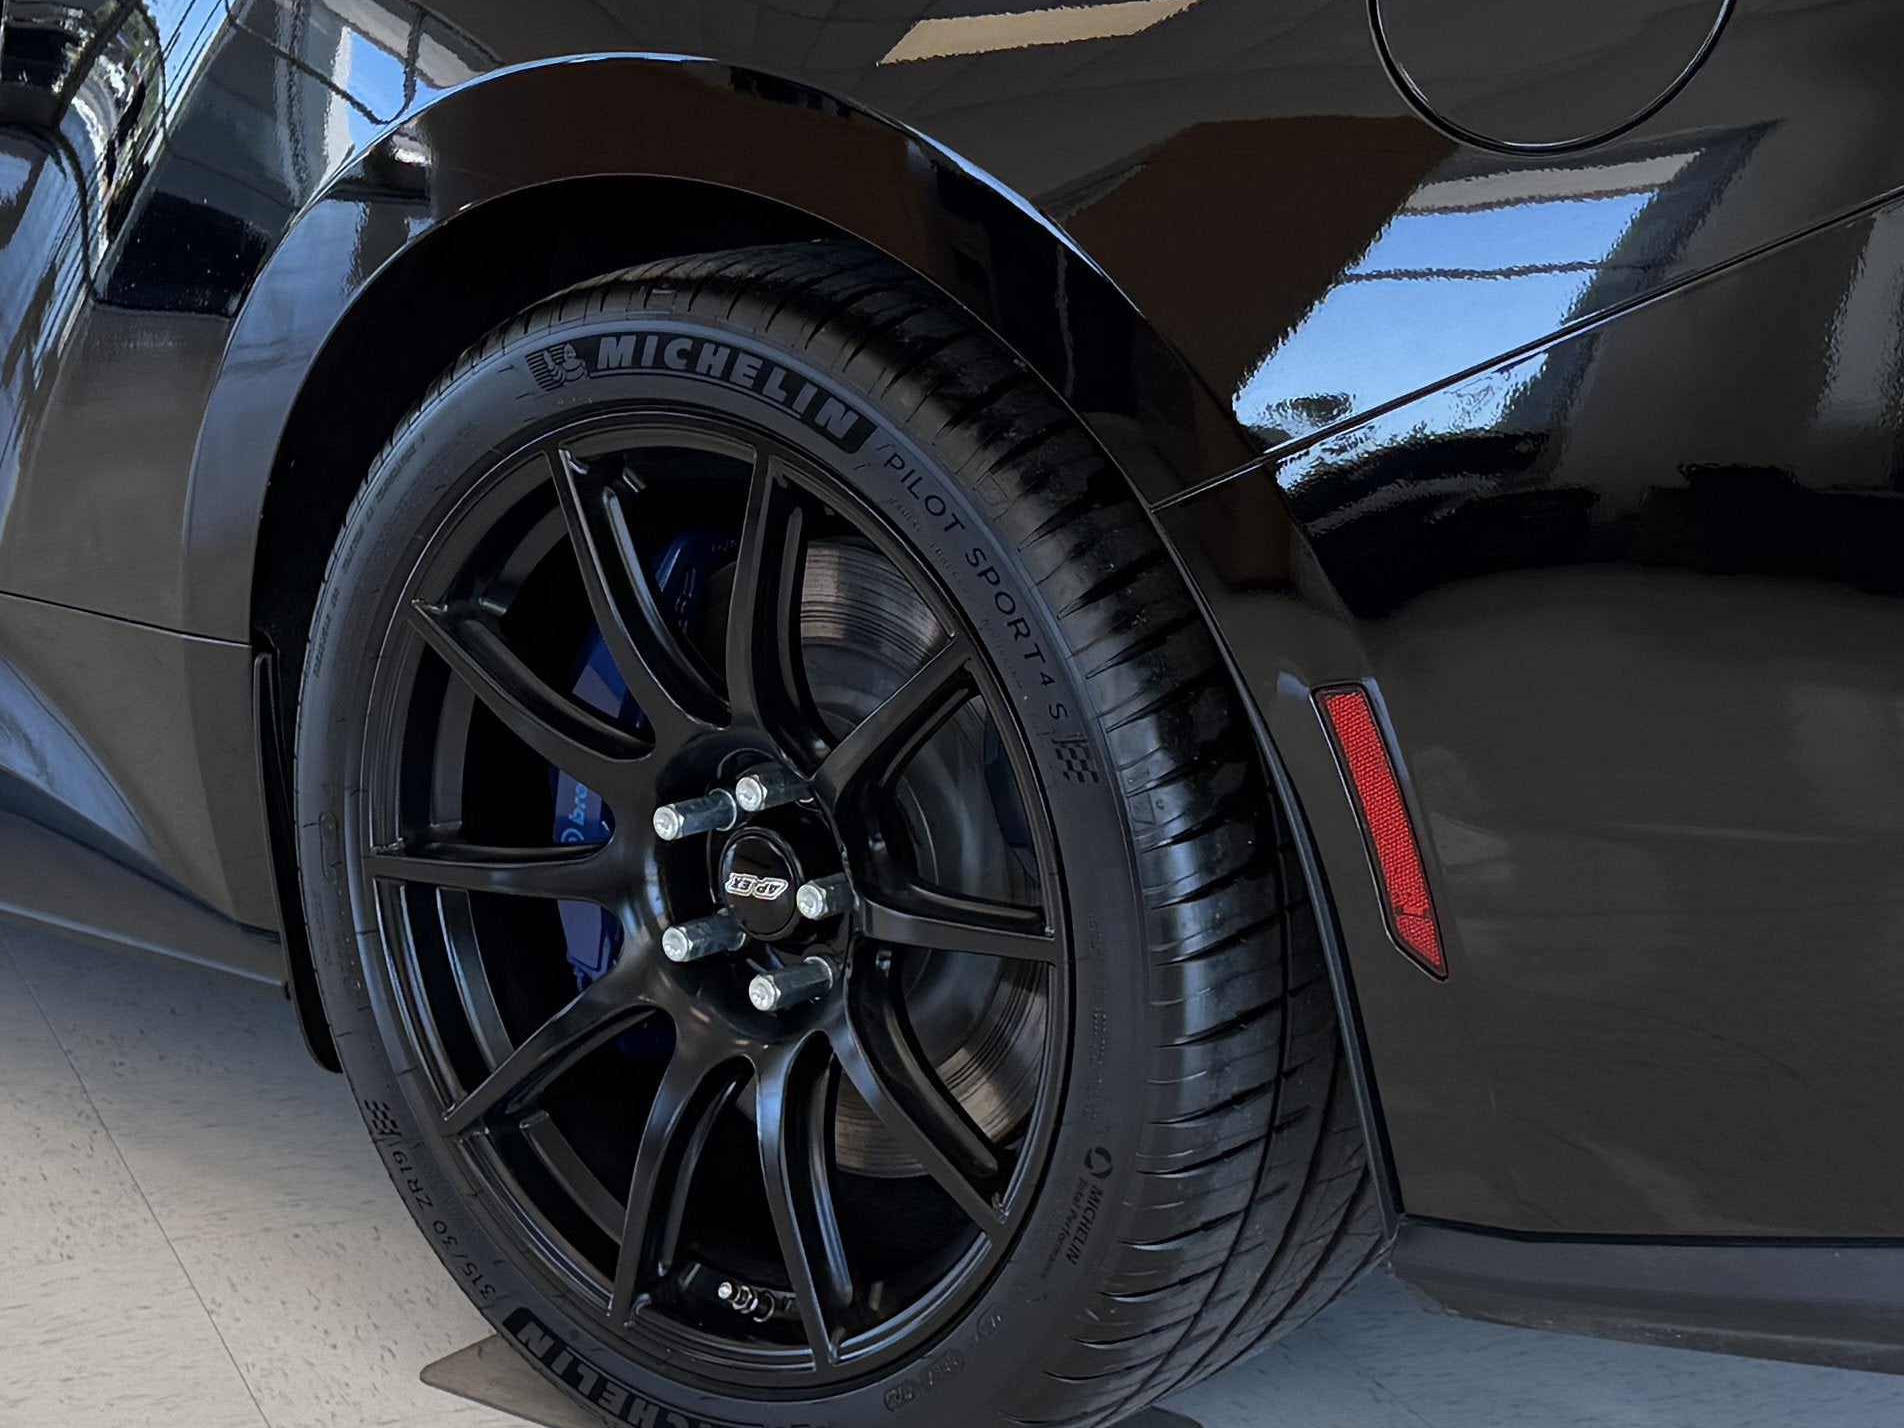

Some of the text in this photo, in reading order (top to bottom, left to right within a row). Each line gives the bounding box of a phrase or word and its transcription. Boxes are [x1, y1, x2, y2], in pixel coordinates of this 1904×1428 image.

[596, 333, 858, 441] MICHELIN
[884, 452, 1069, 722] PILOT SPORT 4 S
[392, 1149, 497, 1298] 315/30 ZR19
[1066, 1185, 1102, 1266] MICHELIN
